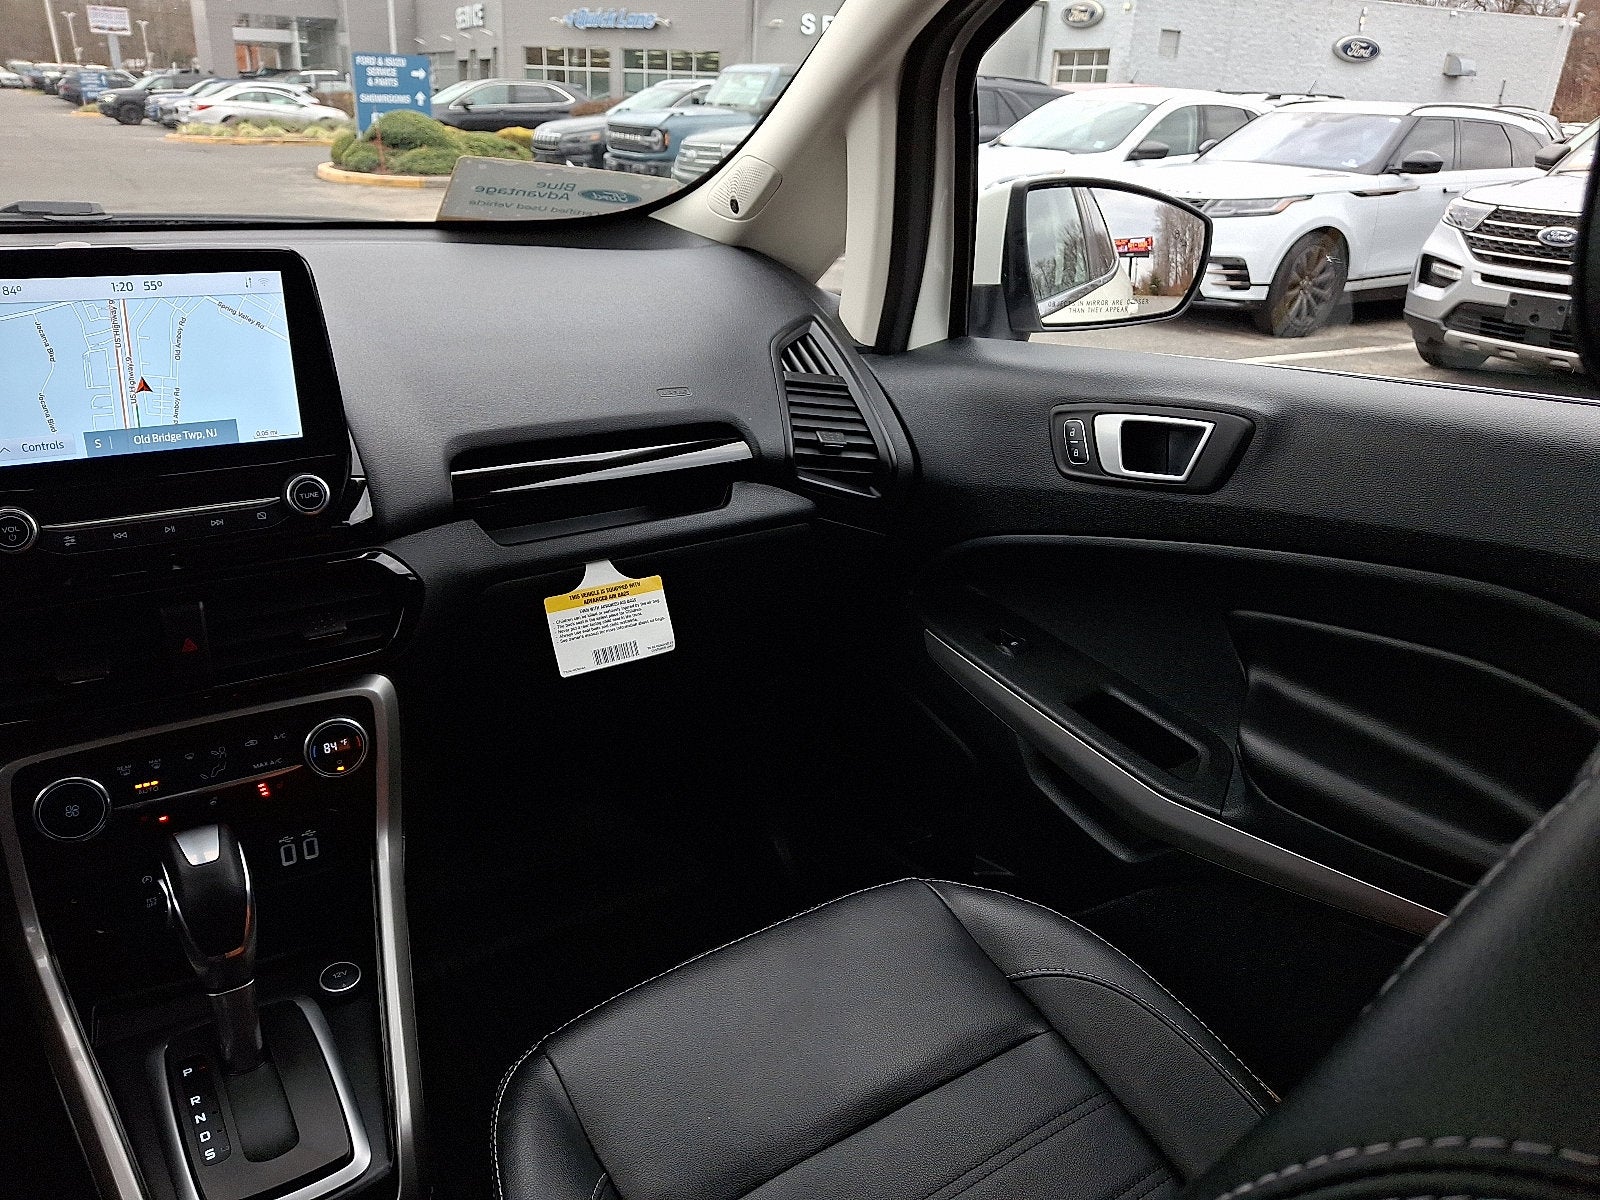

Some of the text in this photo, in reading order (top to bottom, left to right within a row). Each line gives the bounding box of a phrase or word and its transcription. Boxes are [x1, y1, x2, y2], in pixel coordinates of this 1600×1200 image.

[356, 55, 376, 66] FORD
[366, 66, 397, 77] SERVICE
[374, 77, 399, 87] PARTS
[359, 93, 411, 104] SHOWROOMS
[111, 281, 134, 292] 1:20
[110, 305, 121, 337] Highway
[218, 301, 265, 330] Spring Valley Rd
[179, 317, 187, 326] Rd
[114, 337, 122, 348] US
[175, 327, 184, 349] Amboy
[129, 393, 137, 404] US
[94, 428, 218, 449] S Old Bridge Twp, NJ
[21, 440, 65, 453] Controls
[299, 491, 319, 499] TUNE
[1, 525, 20, 533] VOL
[323, 741, 338, 754] 84
[252, 761, 268, 769] MAX
[138, 785, 159, 794] AUTO
[332, 969, 347, 978] 12V
[182, 1067, 193, 1077] P
[190, 1095, 201, 1106] R
[194, 1112, 207, 1124] N
[199, 1130, 211, 1142] D
[204, 1147, 216, 1160] S
